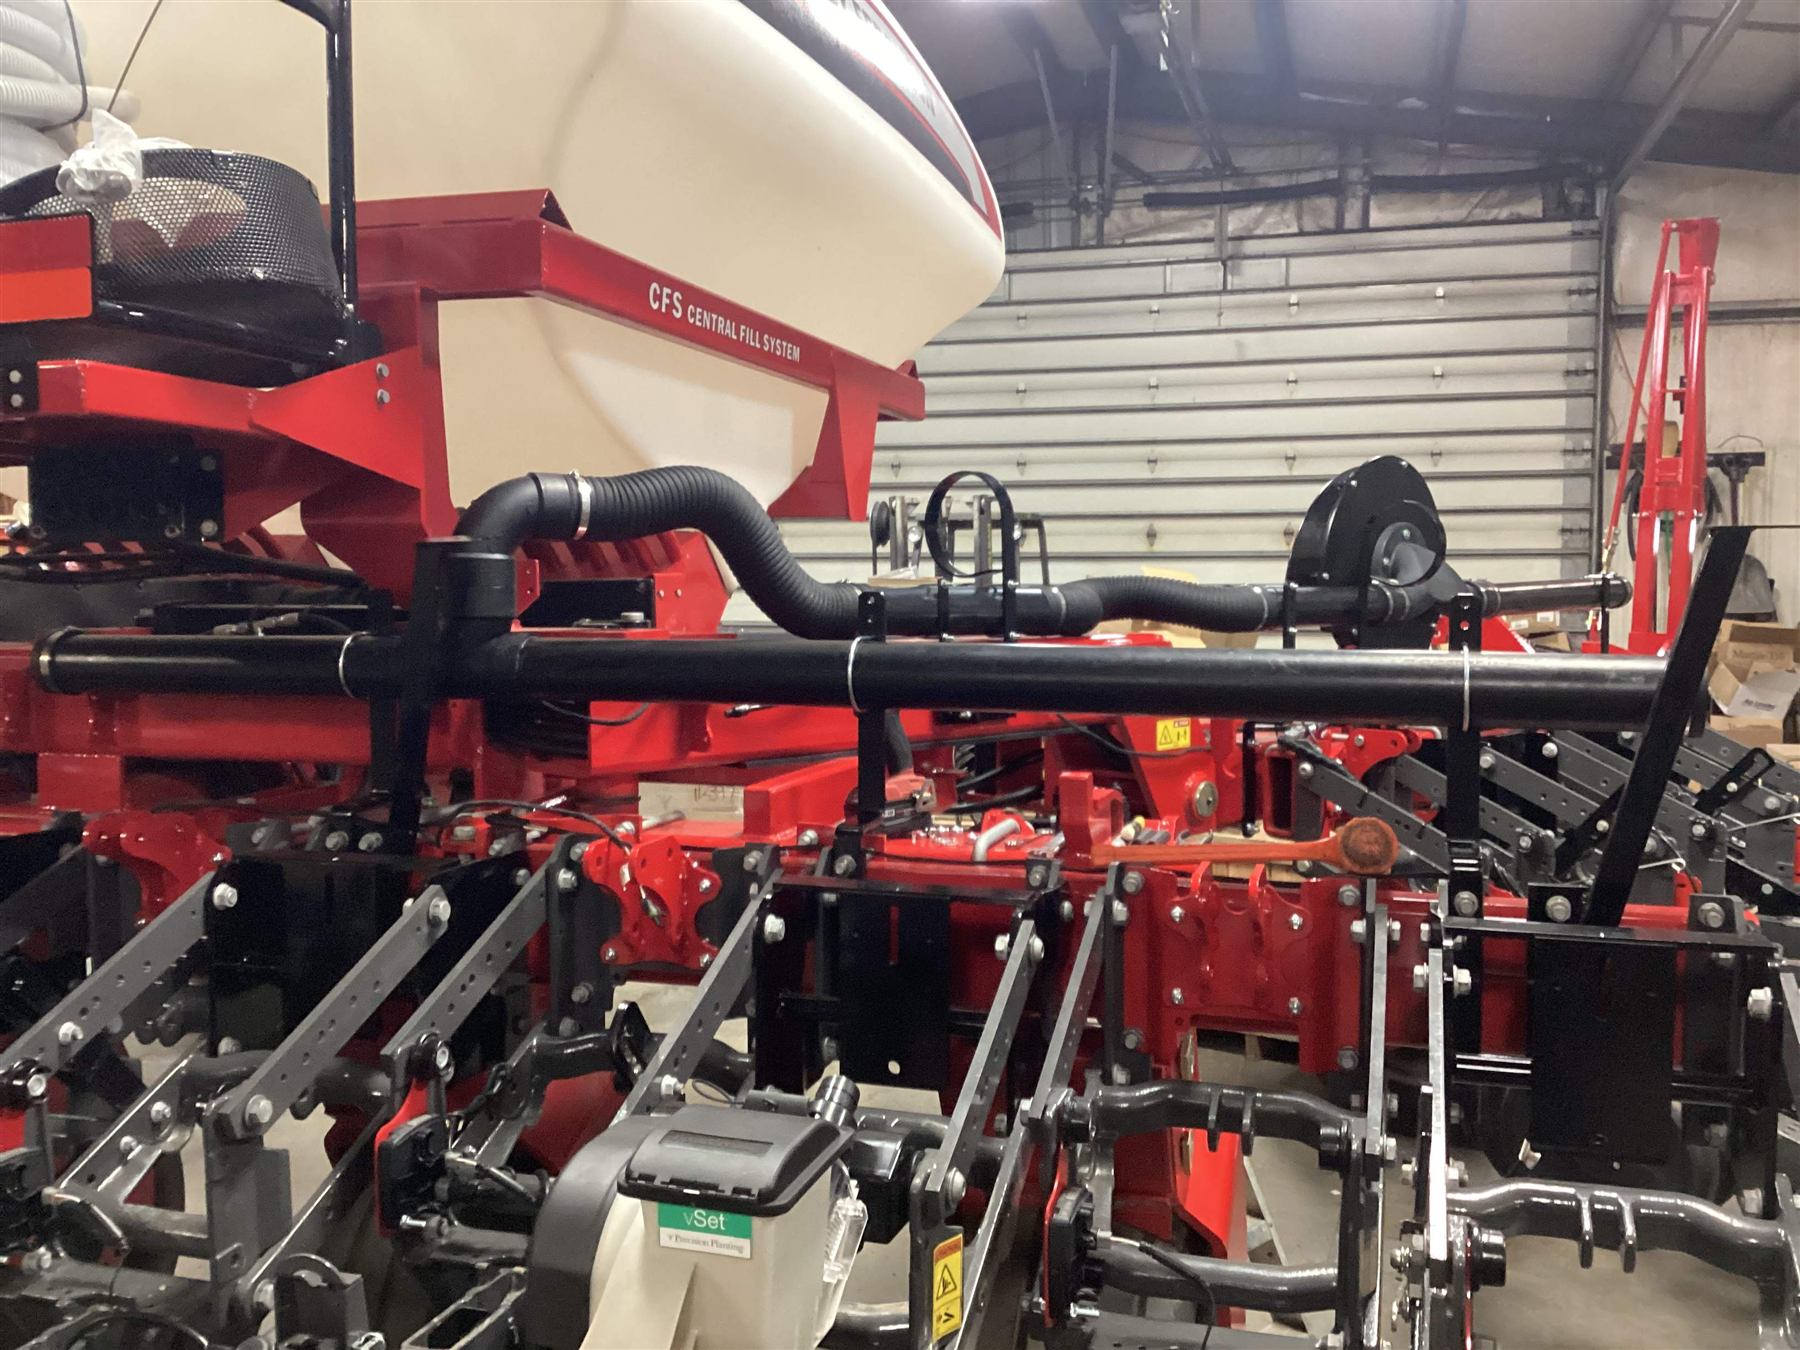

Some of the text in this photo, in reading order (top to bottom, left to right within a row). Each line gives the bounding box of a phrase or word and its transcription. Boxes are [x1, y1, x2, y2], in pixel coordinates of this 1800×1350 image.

[649, 282, 800, 363] CFS CENTRAL FILL SYSTEM
[683, 1209, 725, 1230] vSet
